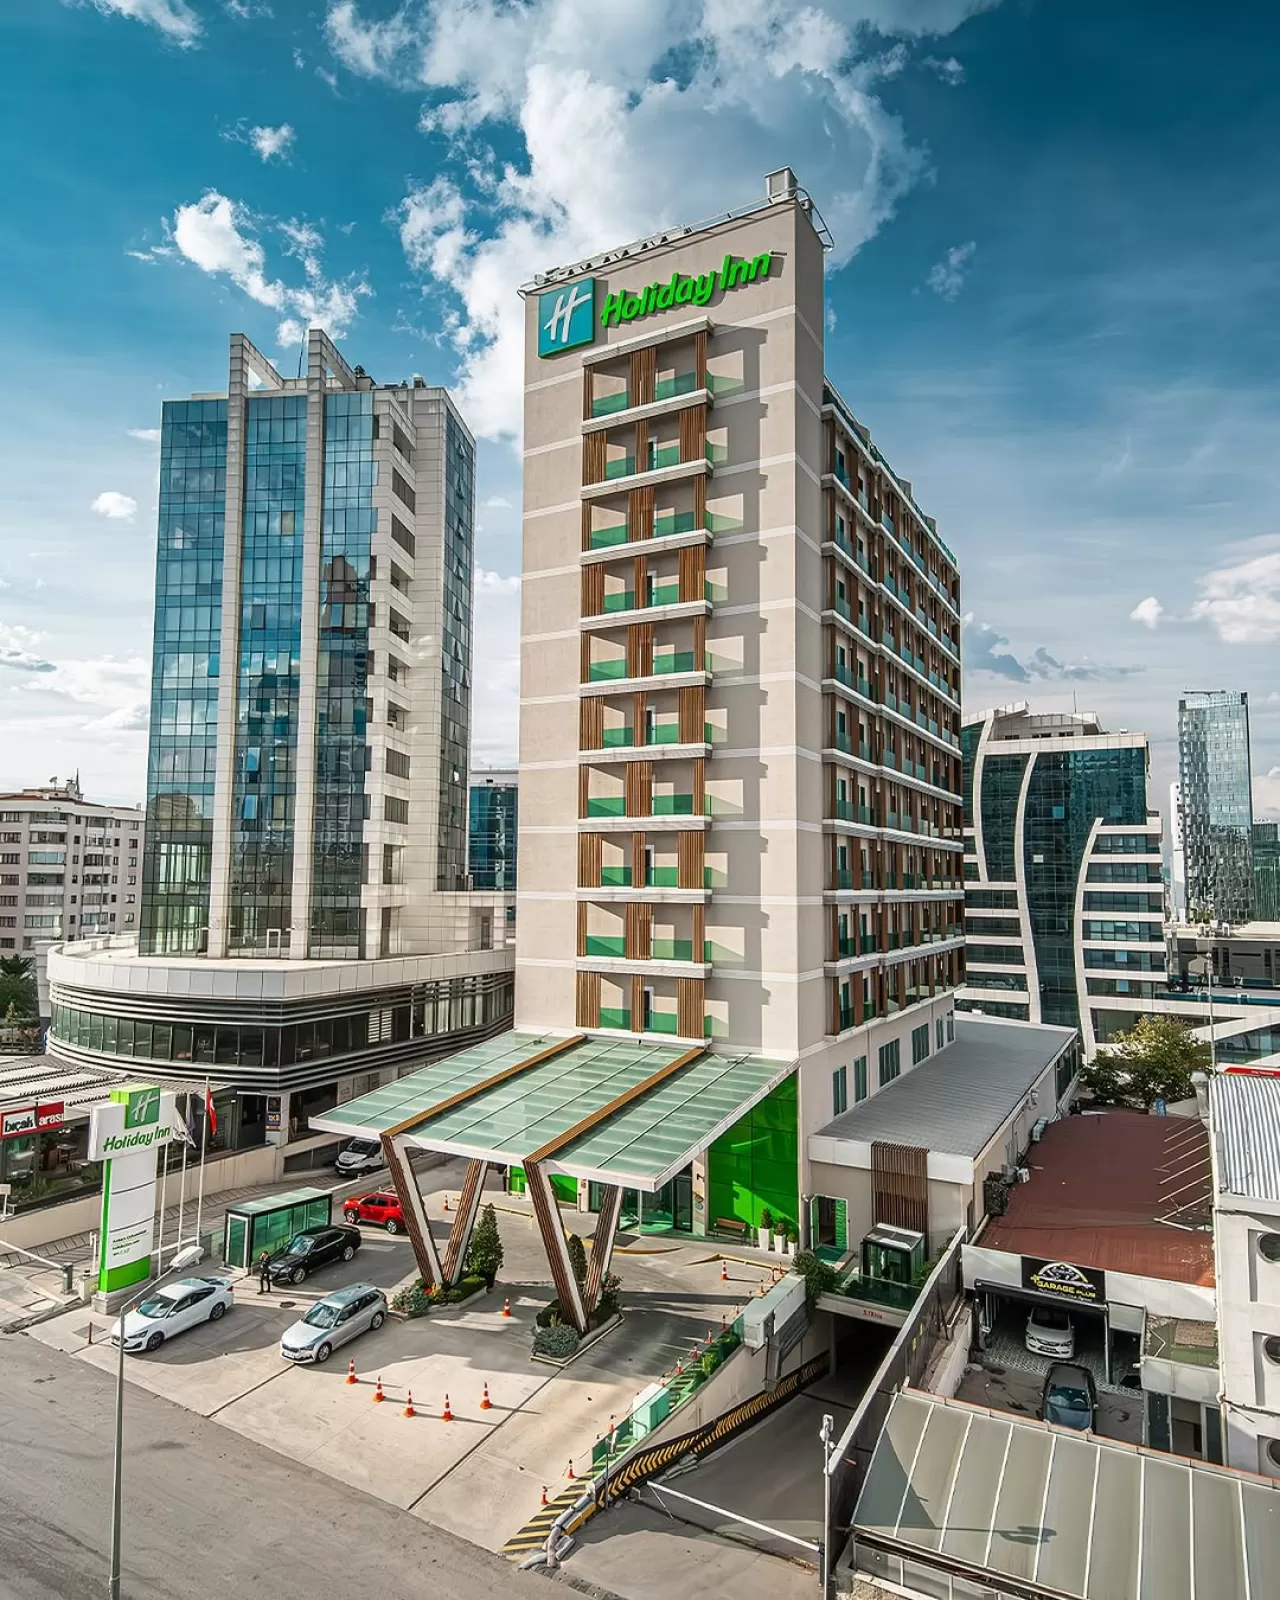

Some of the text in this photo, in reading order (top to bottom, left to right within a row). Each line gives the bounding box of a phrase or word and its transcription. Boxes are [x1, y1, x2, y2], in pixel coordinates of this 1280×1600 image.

[601, 253, 771, 327] Holiday Inn
[103, 1126, 171, 1152] Holiday Inn
[1036, 1280, 1075, 1294] GARAGE
